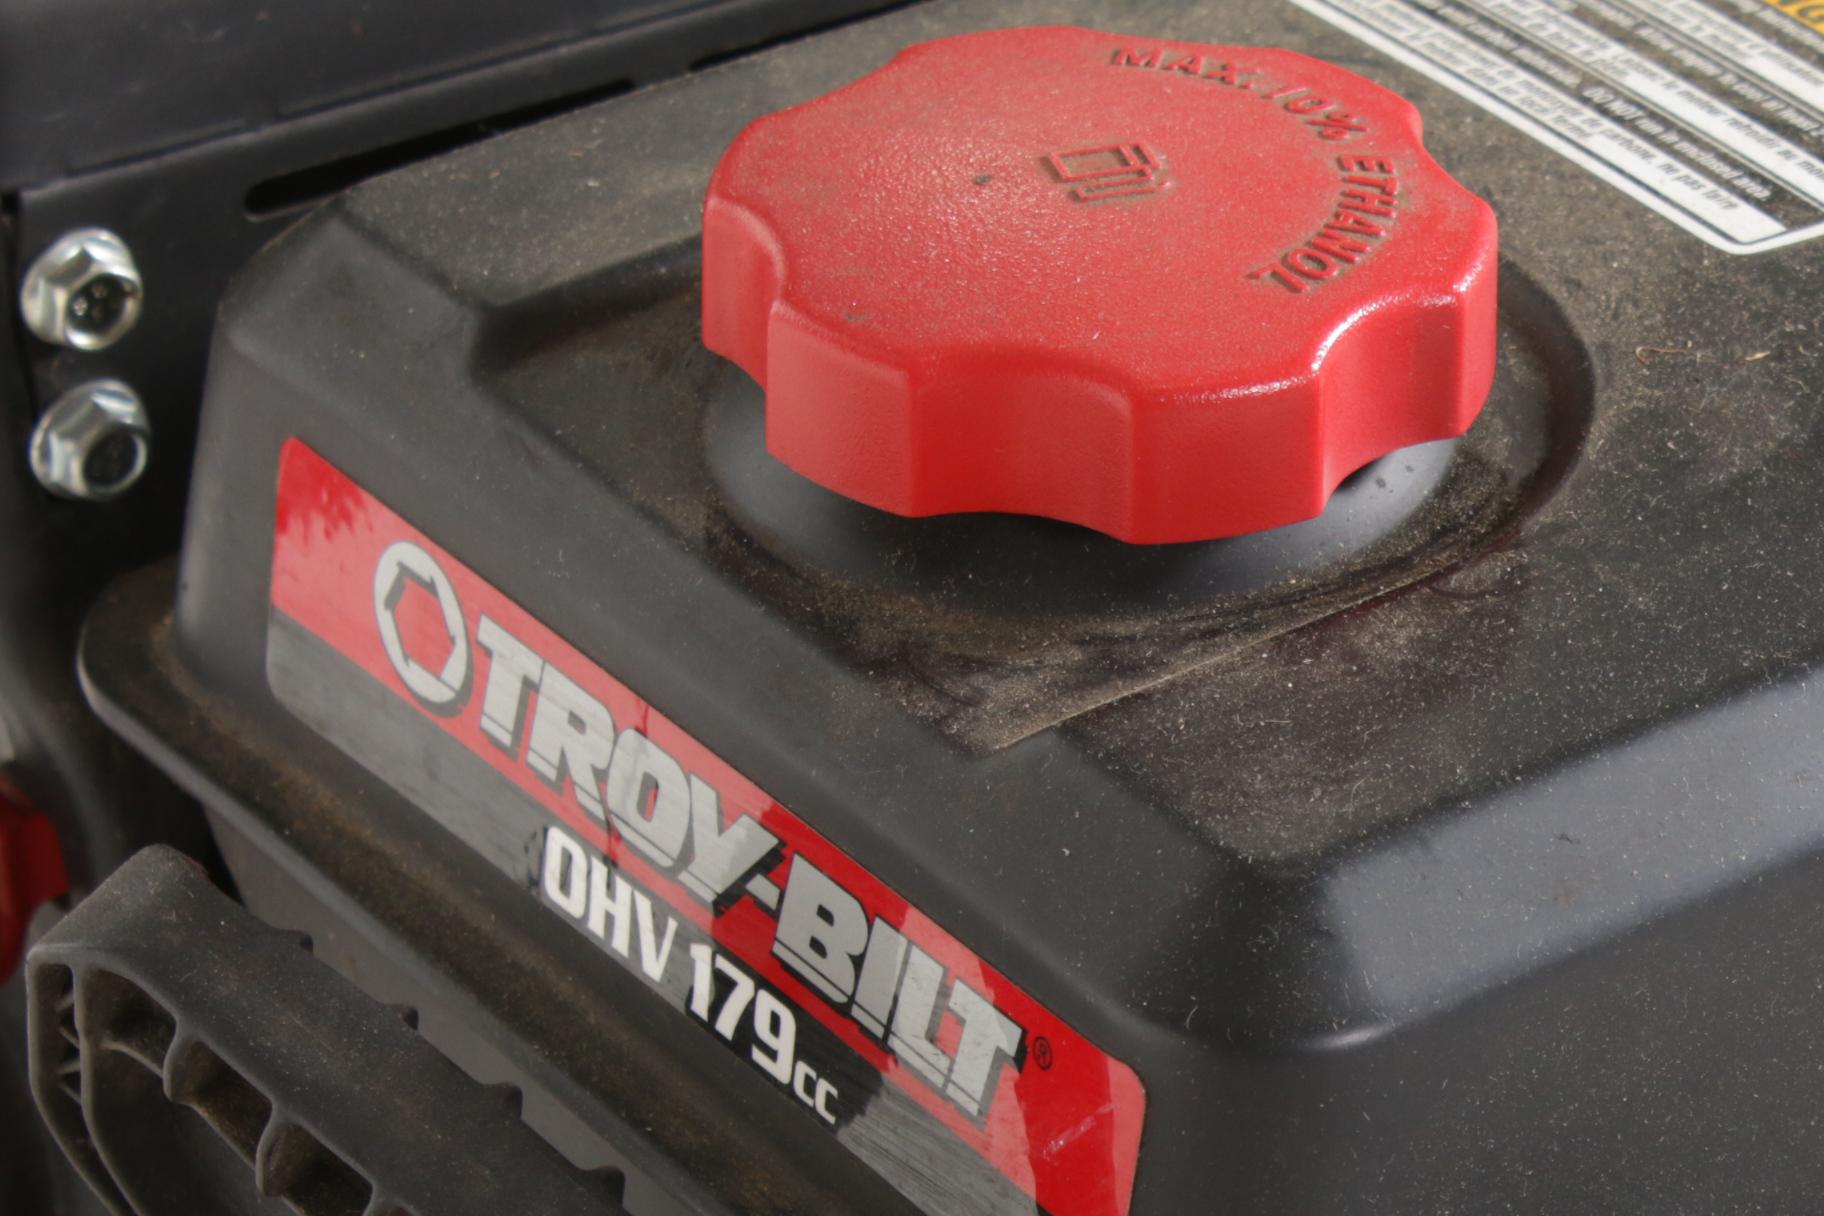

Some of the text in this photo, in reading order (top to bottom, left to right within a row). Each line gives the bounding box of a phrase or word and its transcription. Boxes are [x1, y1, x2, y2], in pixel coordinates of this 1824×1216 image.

[1246, 153, 1402, 294] ETHANOL
[542, 826, 839, 1125] OHV 179cc
